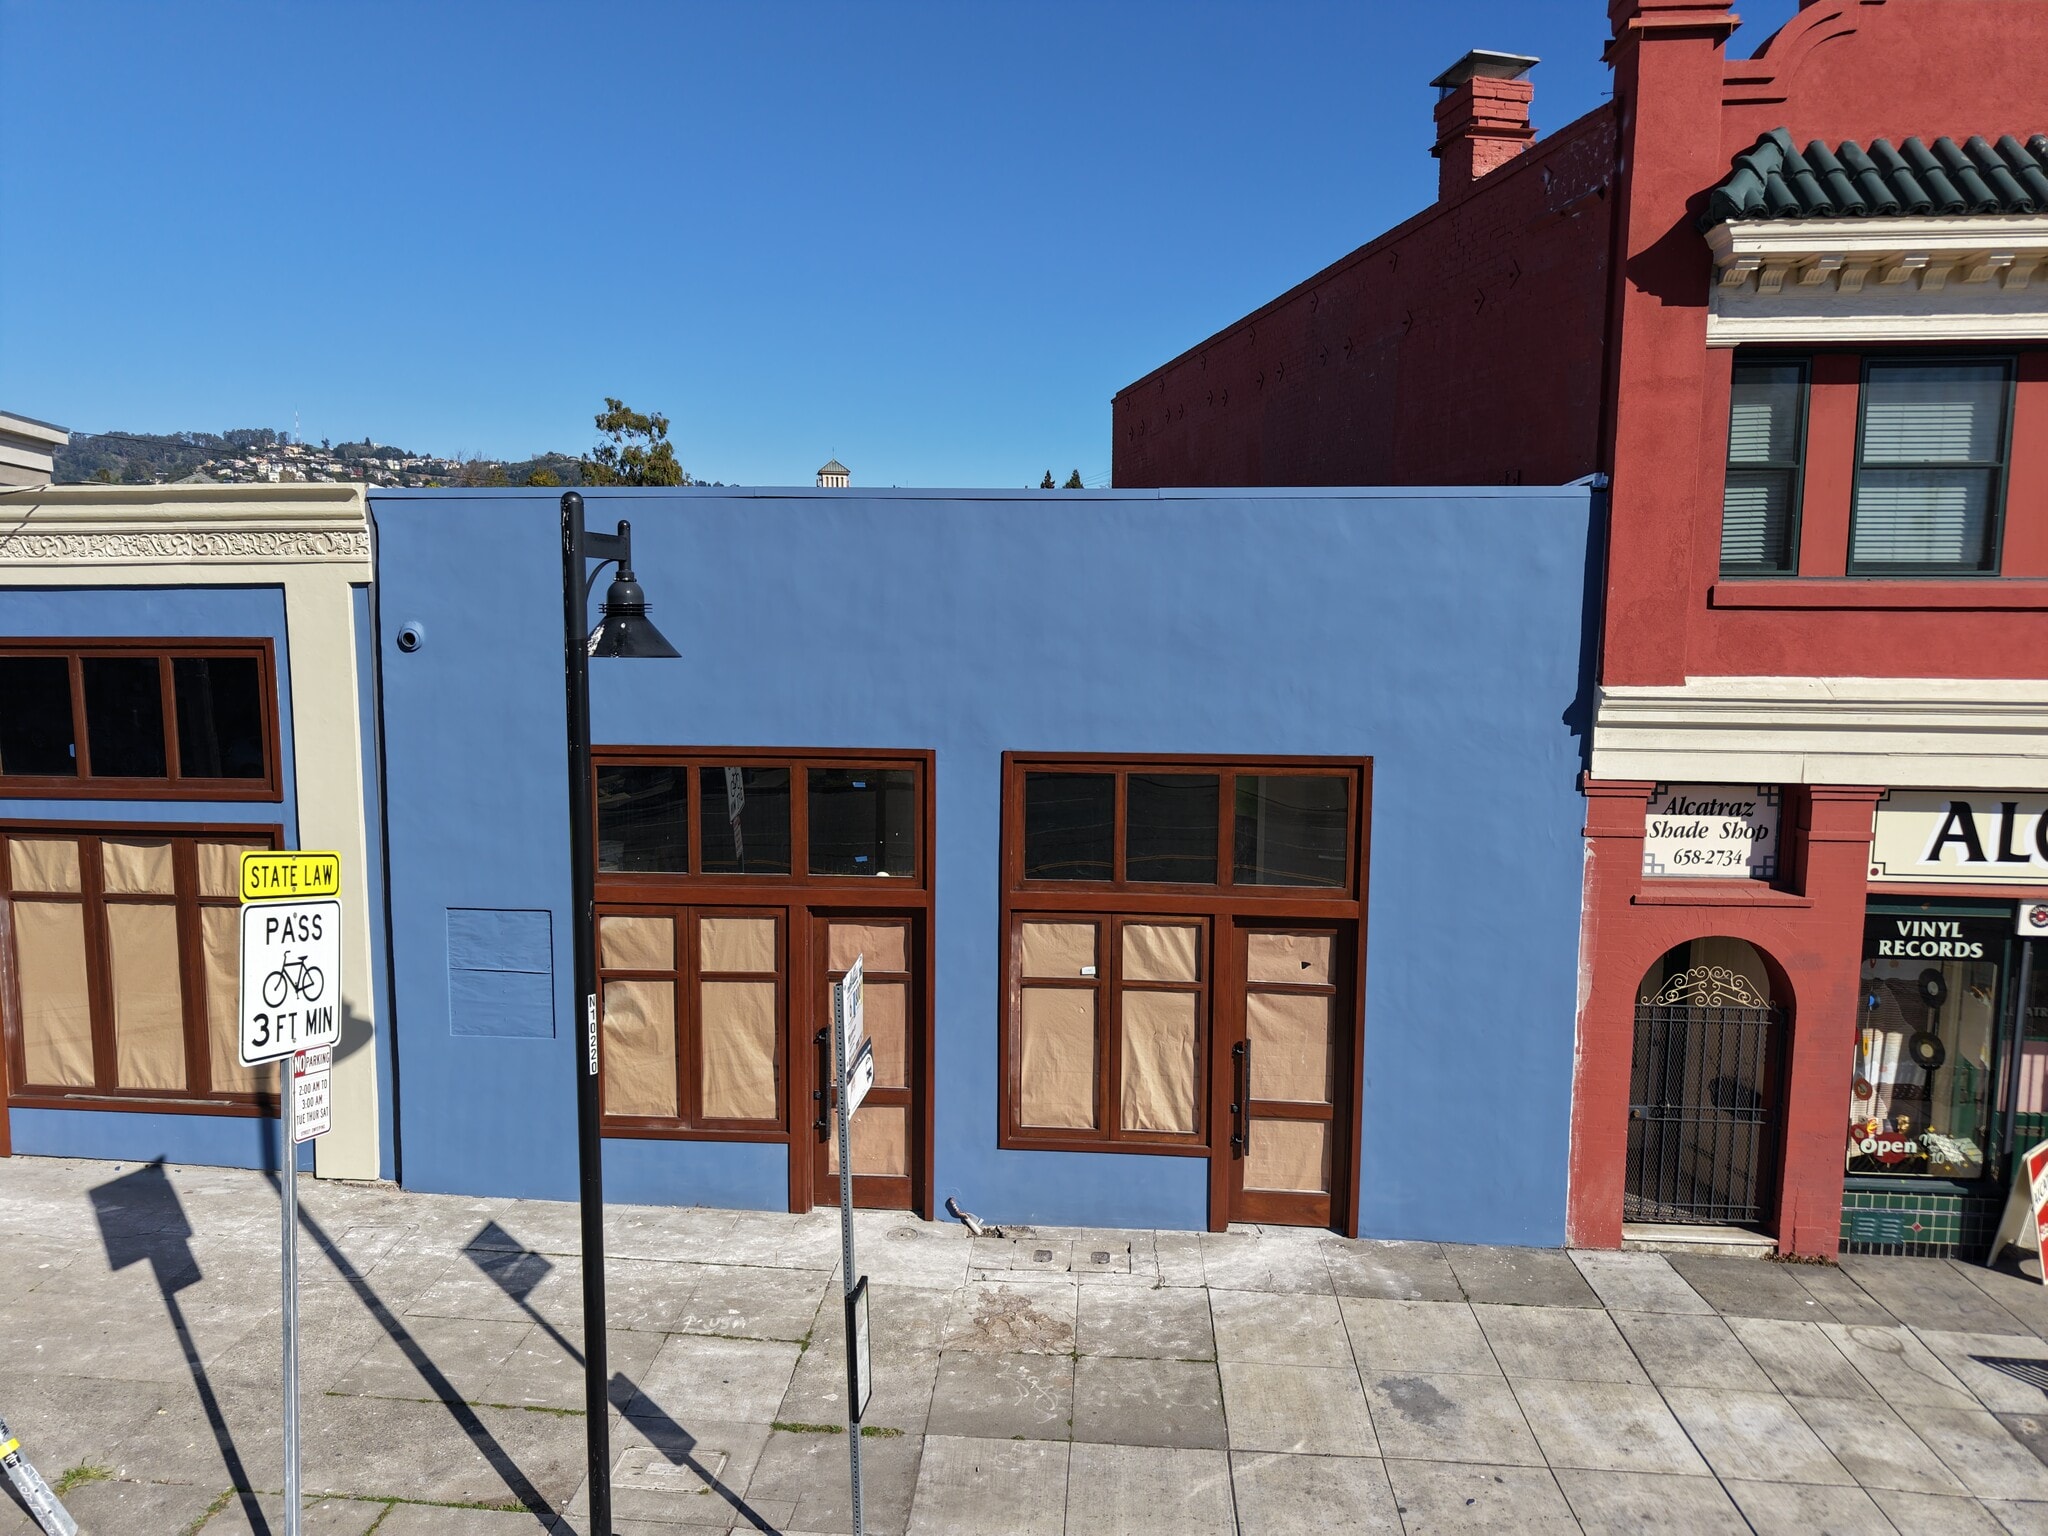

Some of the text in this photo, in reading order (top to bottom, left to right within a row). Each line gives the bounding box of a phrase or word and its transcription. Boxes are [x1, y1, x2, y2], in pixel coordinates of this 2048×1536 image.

[1663, 796, 1756, 817] Alcatraz
[1649, 821, 1769, 842] Shade Shop
[1926, 801, 2048, 864] AL
[1673, 848, 1742, 867] 658-2734
[251, 864, 333, 889] STATE LAW
[266, 913, 323, 946] PASS
[1896, 920, 1964, 938] VINYL
[1878, 940, 1984, 959] RECORDS
[251, 1005, 333, 1047] 3 FT MIN
[294, 1052, 330, 1075] NO PARKING
[299, 1079, 328, 1096] 2:00 AM TO
[302, 1094, 323, 1109] 3:00 AM
[297, 1113, 306, 1125] TUE
[320, 1106, 329, 1119] SAT
[1860, 1137, 1918, 1157] Open
